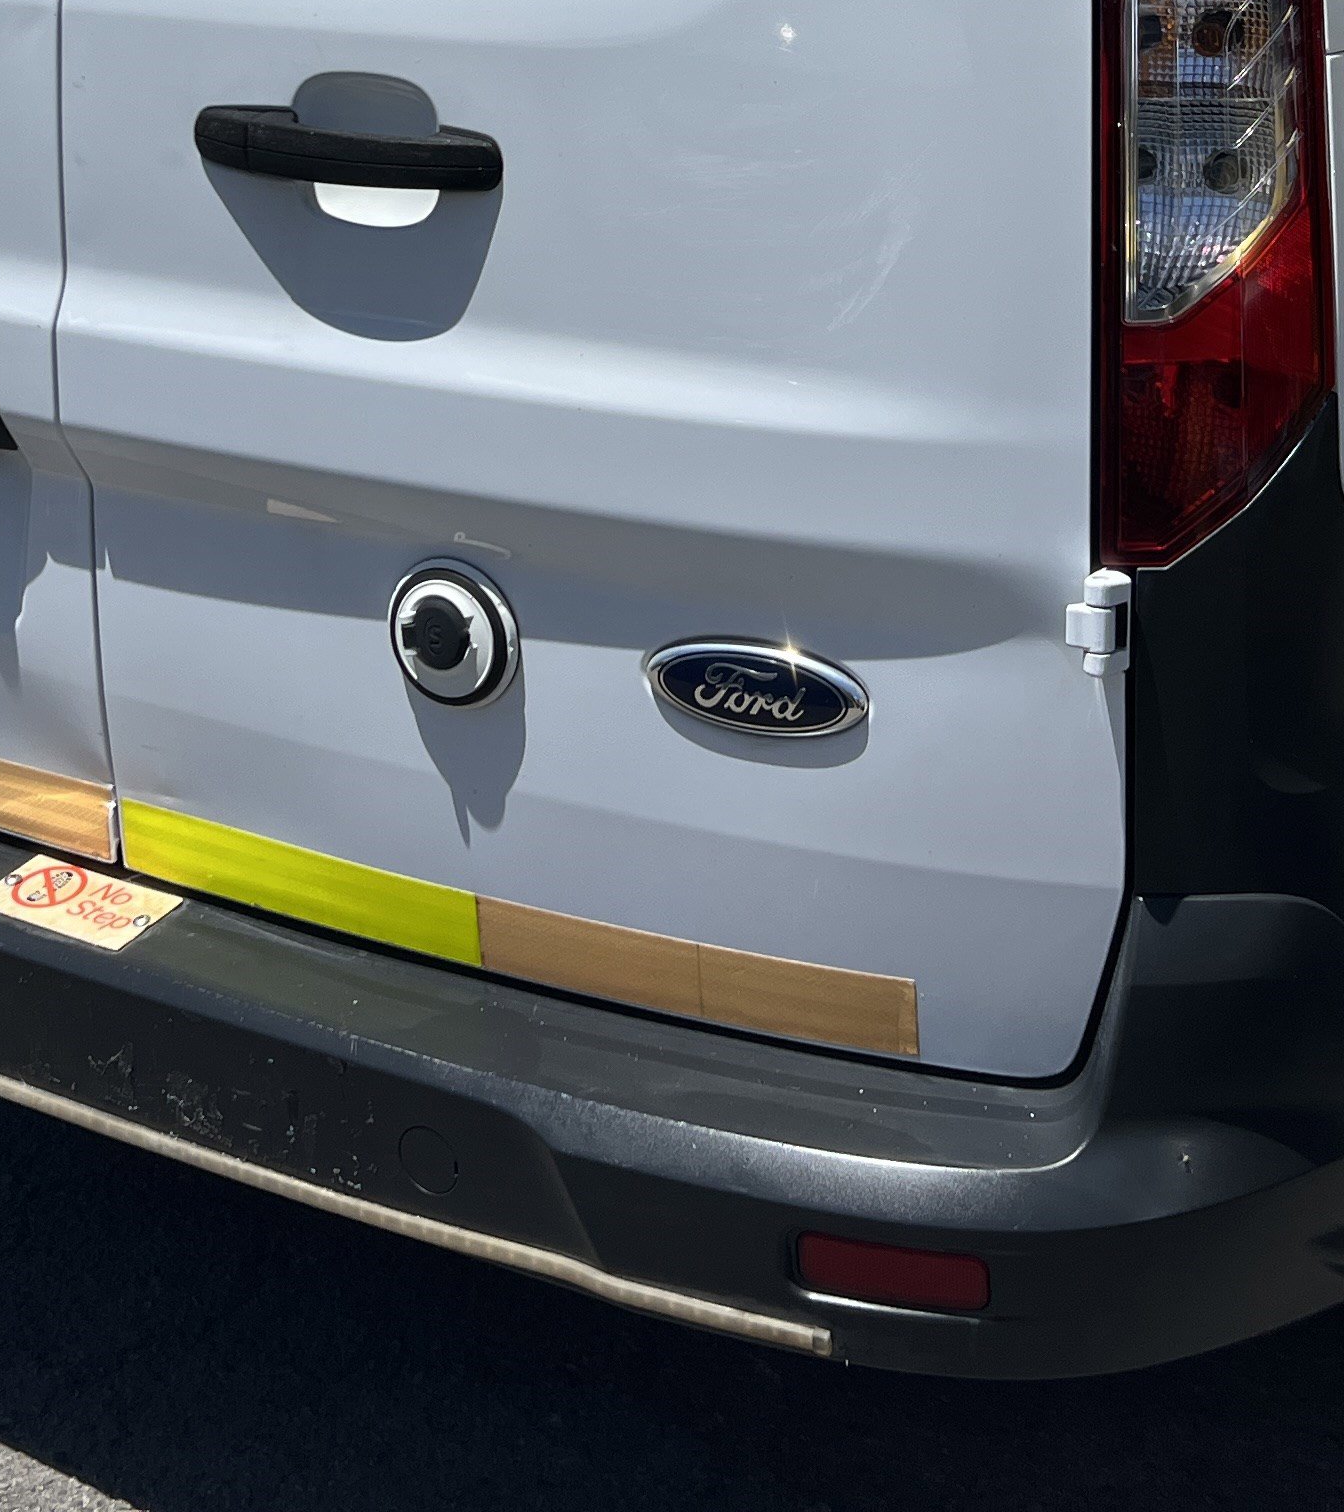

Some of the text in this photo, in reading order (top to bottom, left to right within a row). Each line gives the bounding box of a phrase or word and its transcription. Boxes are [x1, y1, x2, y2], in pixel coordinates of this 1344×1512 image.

[694, 663, 807, 721] Ford
[89, 884, 132, 906] No
[67, 900, 132, 930] Step
